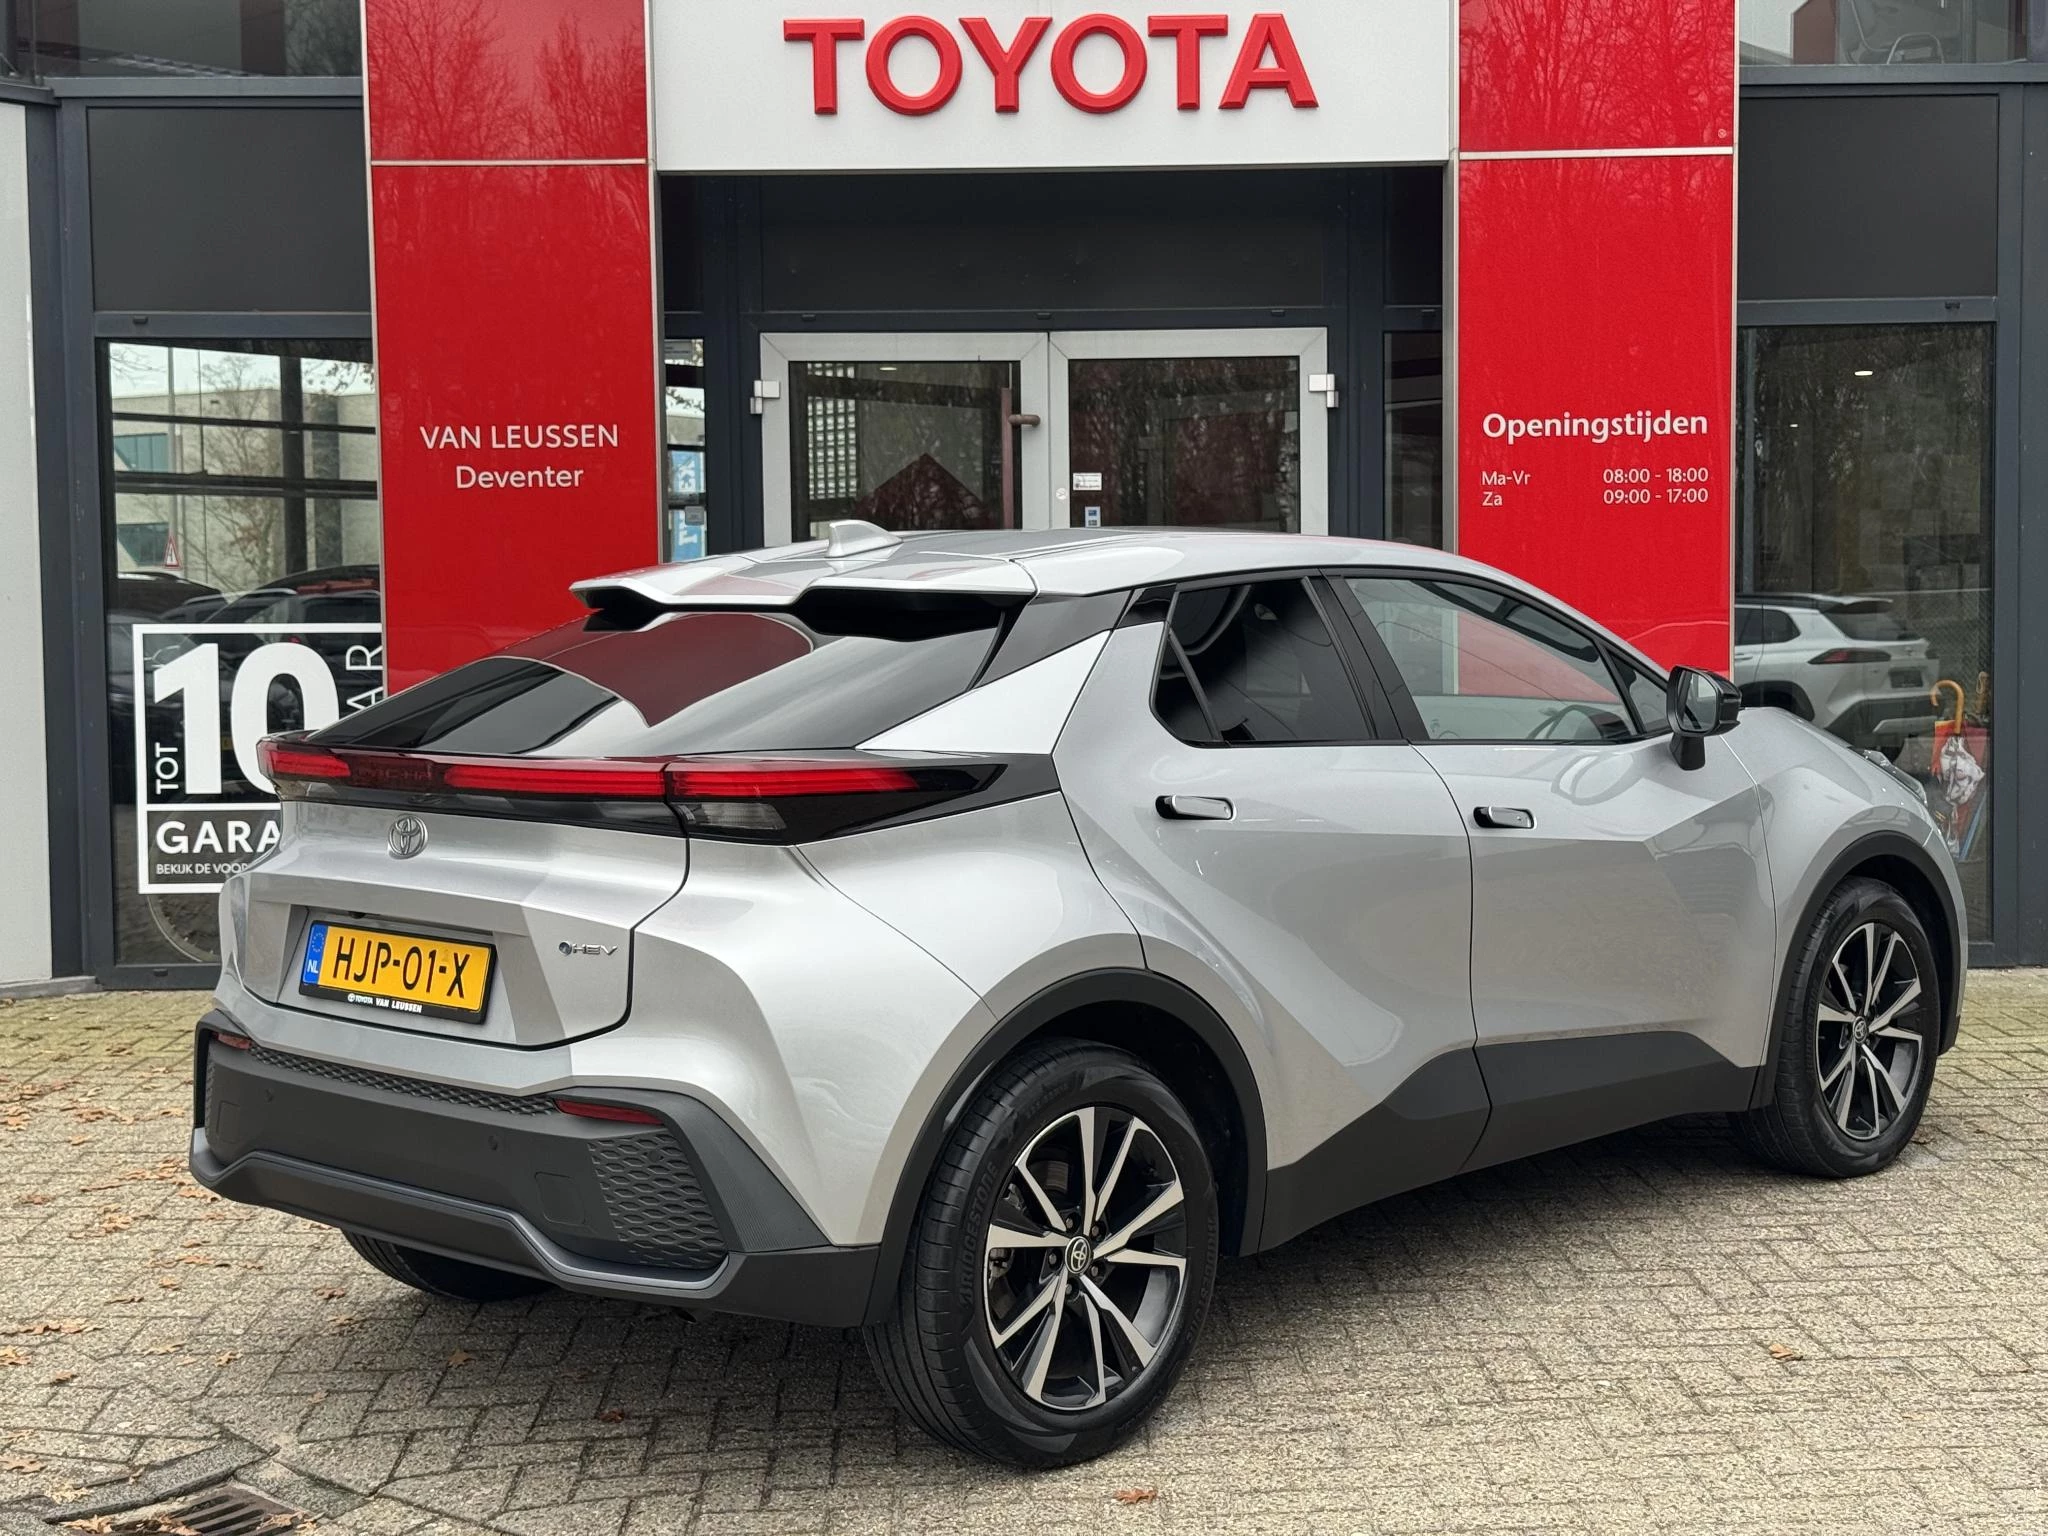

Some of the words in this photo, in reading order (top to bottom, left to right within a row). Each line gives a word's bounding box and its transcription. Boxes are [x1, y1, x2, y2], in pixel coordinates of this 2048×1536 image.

[784, 13, 1319, 116] TOYOTA
[419, 425, 481, 449] VAN
[491, 424, 619, 449] LEUSSEN
[1482, 409, 1708, 445] Openingstijden
[456, 465, 584, 489] Deventer
[1481, 470, 1532, 486] Ma-Vr
[1603, 468, 1650, 484] 08:00
[1666, 467, 1709, 483] 18:00
[1482, 491, 1503, 506] Za
[1603, 488, 1650, 504] 09:00
[1666, 487, 1709, 503] 17:00
[153, 641, 341, 795] 10
[155, 742, 179, 795] TOT
[156, 820, 281, 854] GARA
[155, 862, 193, 875] BEKIJK
[194, 862, 211, 875] DE
[572, 943, 619, 956] HEV
[307, 958, 319, 974] NL
[332, 936, 470, 999] HJP-01-X
[375, 997, 390, 1008] VAN
[391, 1000, 423, 1013] LEUSSEN
